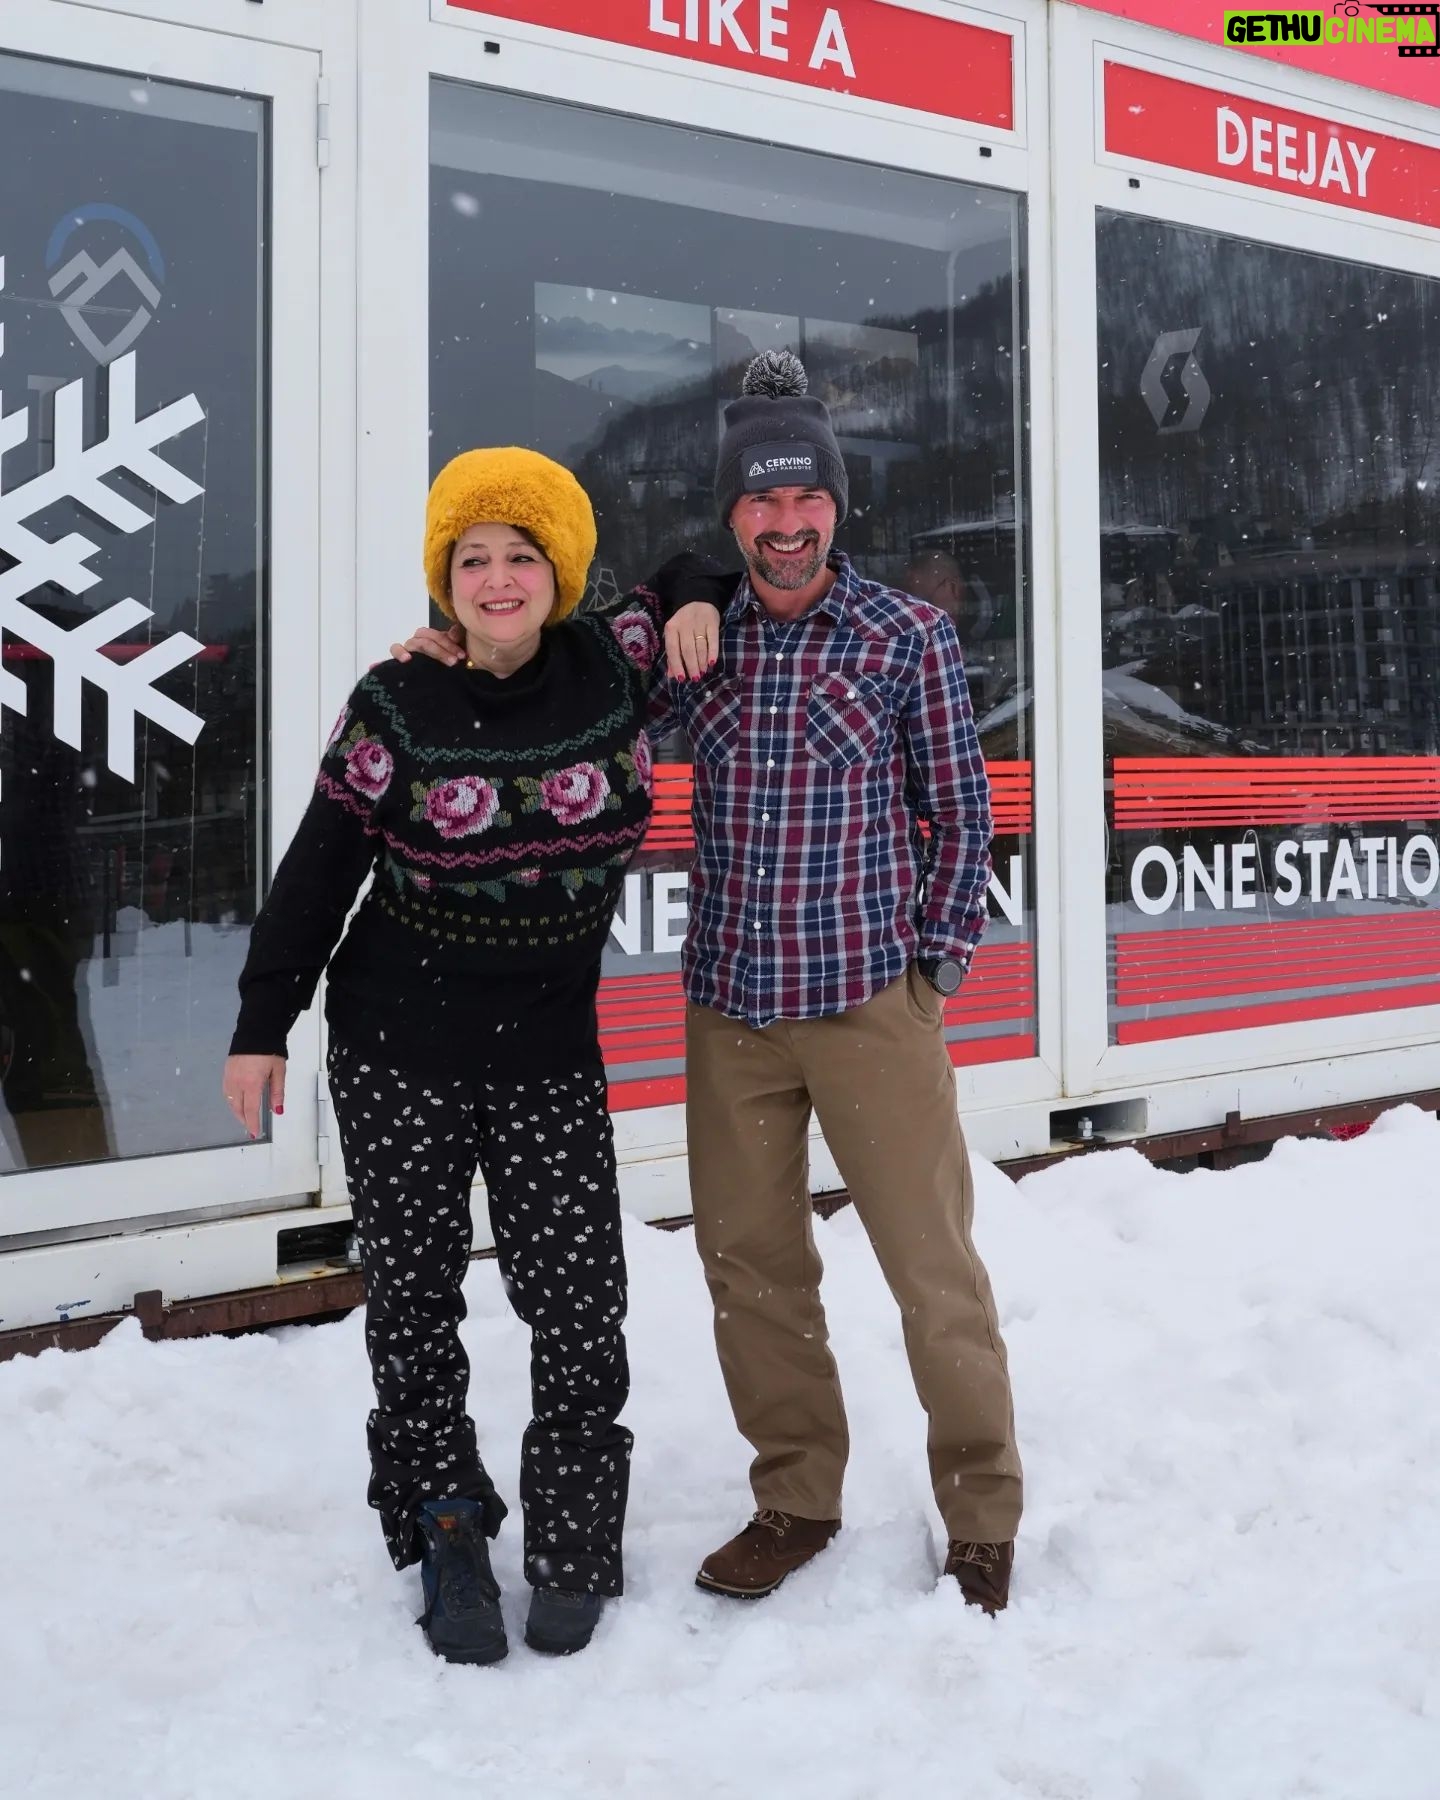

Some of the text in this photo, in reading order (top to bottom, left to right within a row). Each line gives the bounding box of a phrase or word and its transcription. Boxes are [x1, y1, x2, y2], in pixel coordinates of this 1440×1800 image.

[649, 0, 857, 79] LIKE A
[1216, 106, 1377, 198] DEEJAY
[765, 457, 812, 467] CERVINO
[609, 871, 689, 956] NE
[1130, 834, 1440, 916] ONE STATIO
